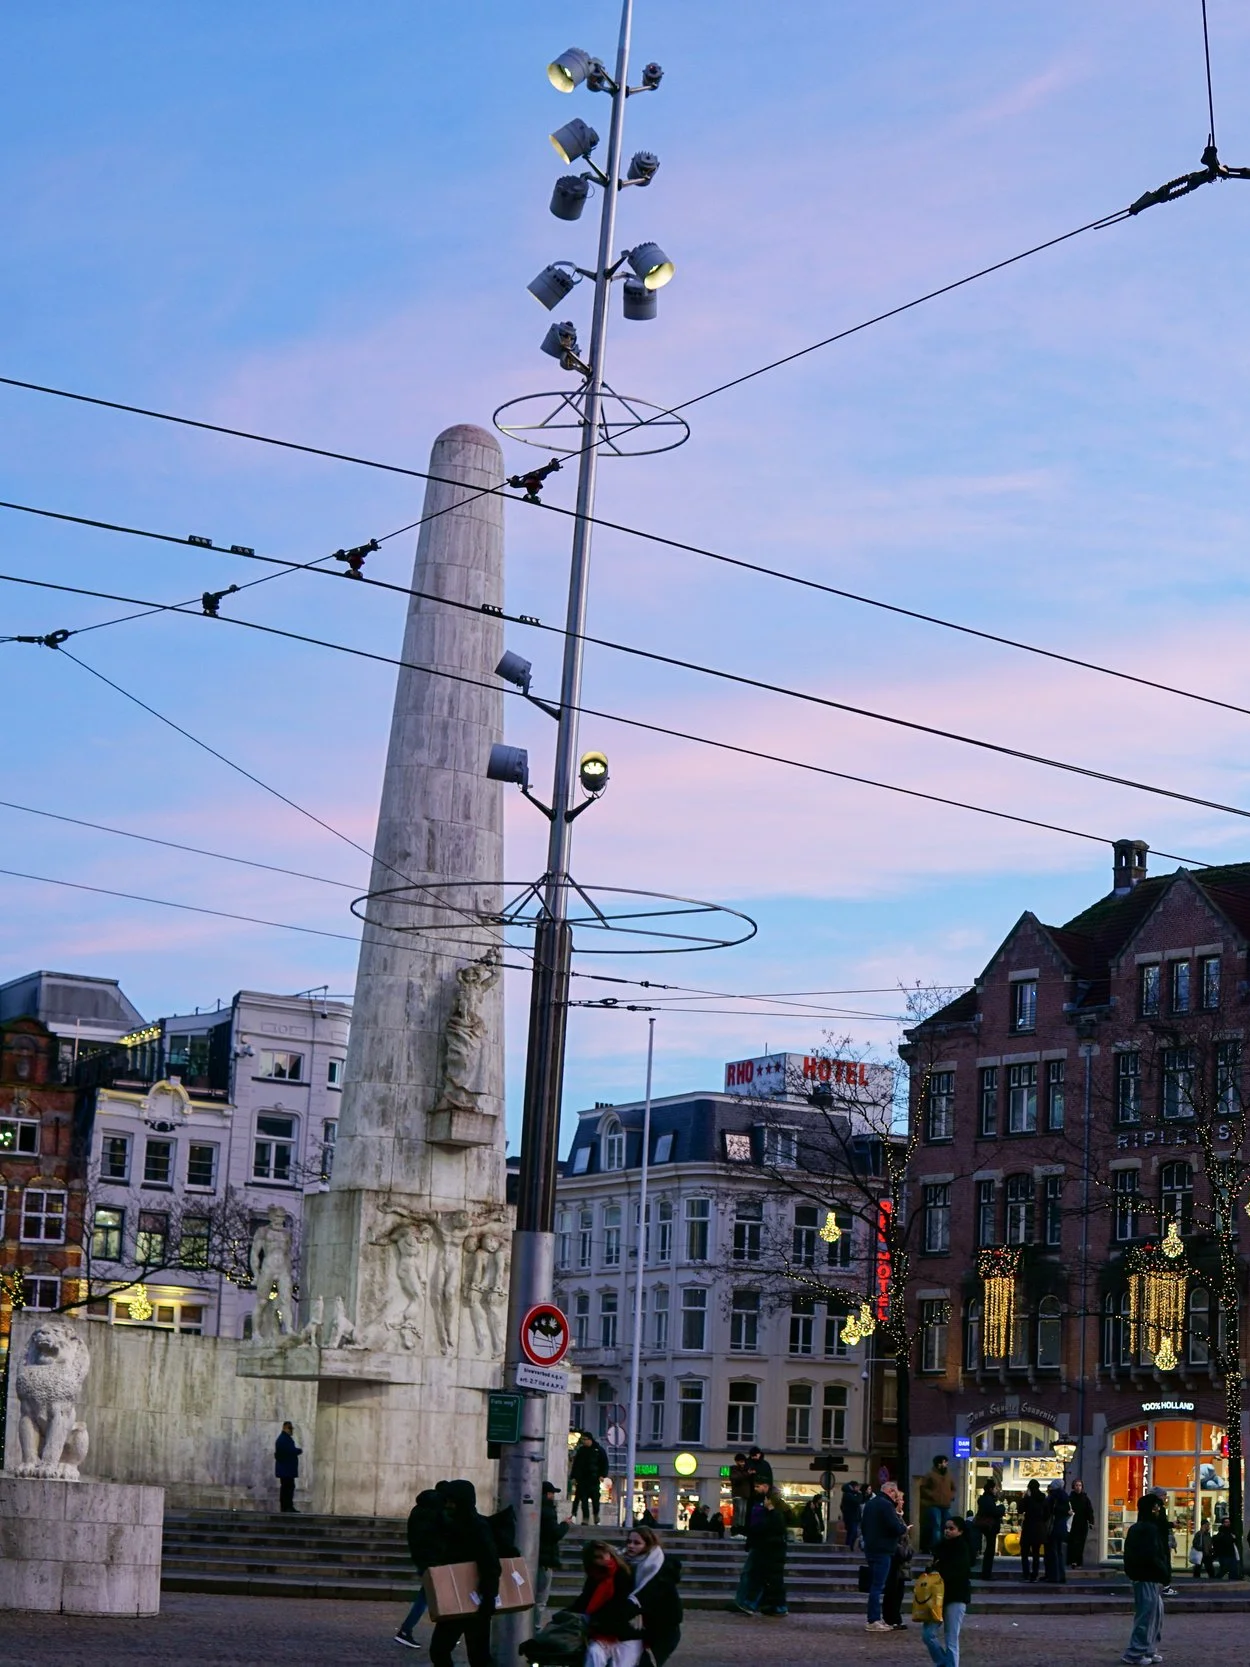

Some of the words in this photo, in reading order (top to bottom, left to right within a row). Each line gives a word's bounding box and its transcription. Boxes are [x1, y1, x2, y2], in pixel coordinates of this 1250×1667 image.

[727, 1060, 754, 1087] RHO
[803, 1056, 869, 1087] HOTEL
[1117, 1124, 1231, 1149] RIPLES
[1141, 1402, 1161, 1412] 100%
[1161, 1400, 1195, 1411] HOLLAND
